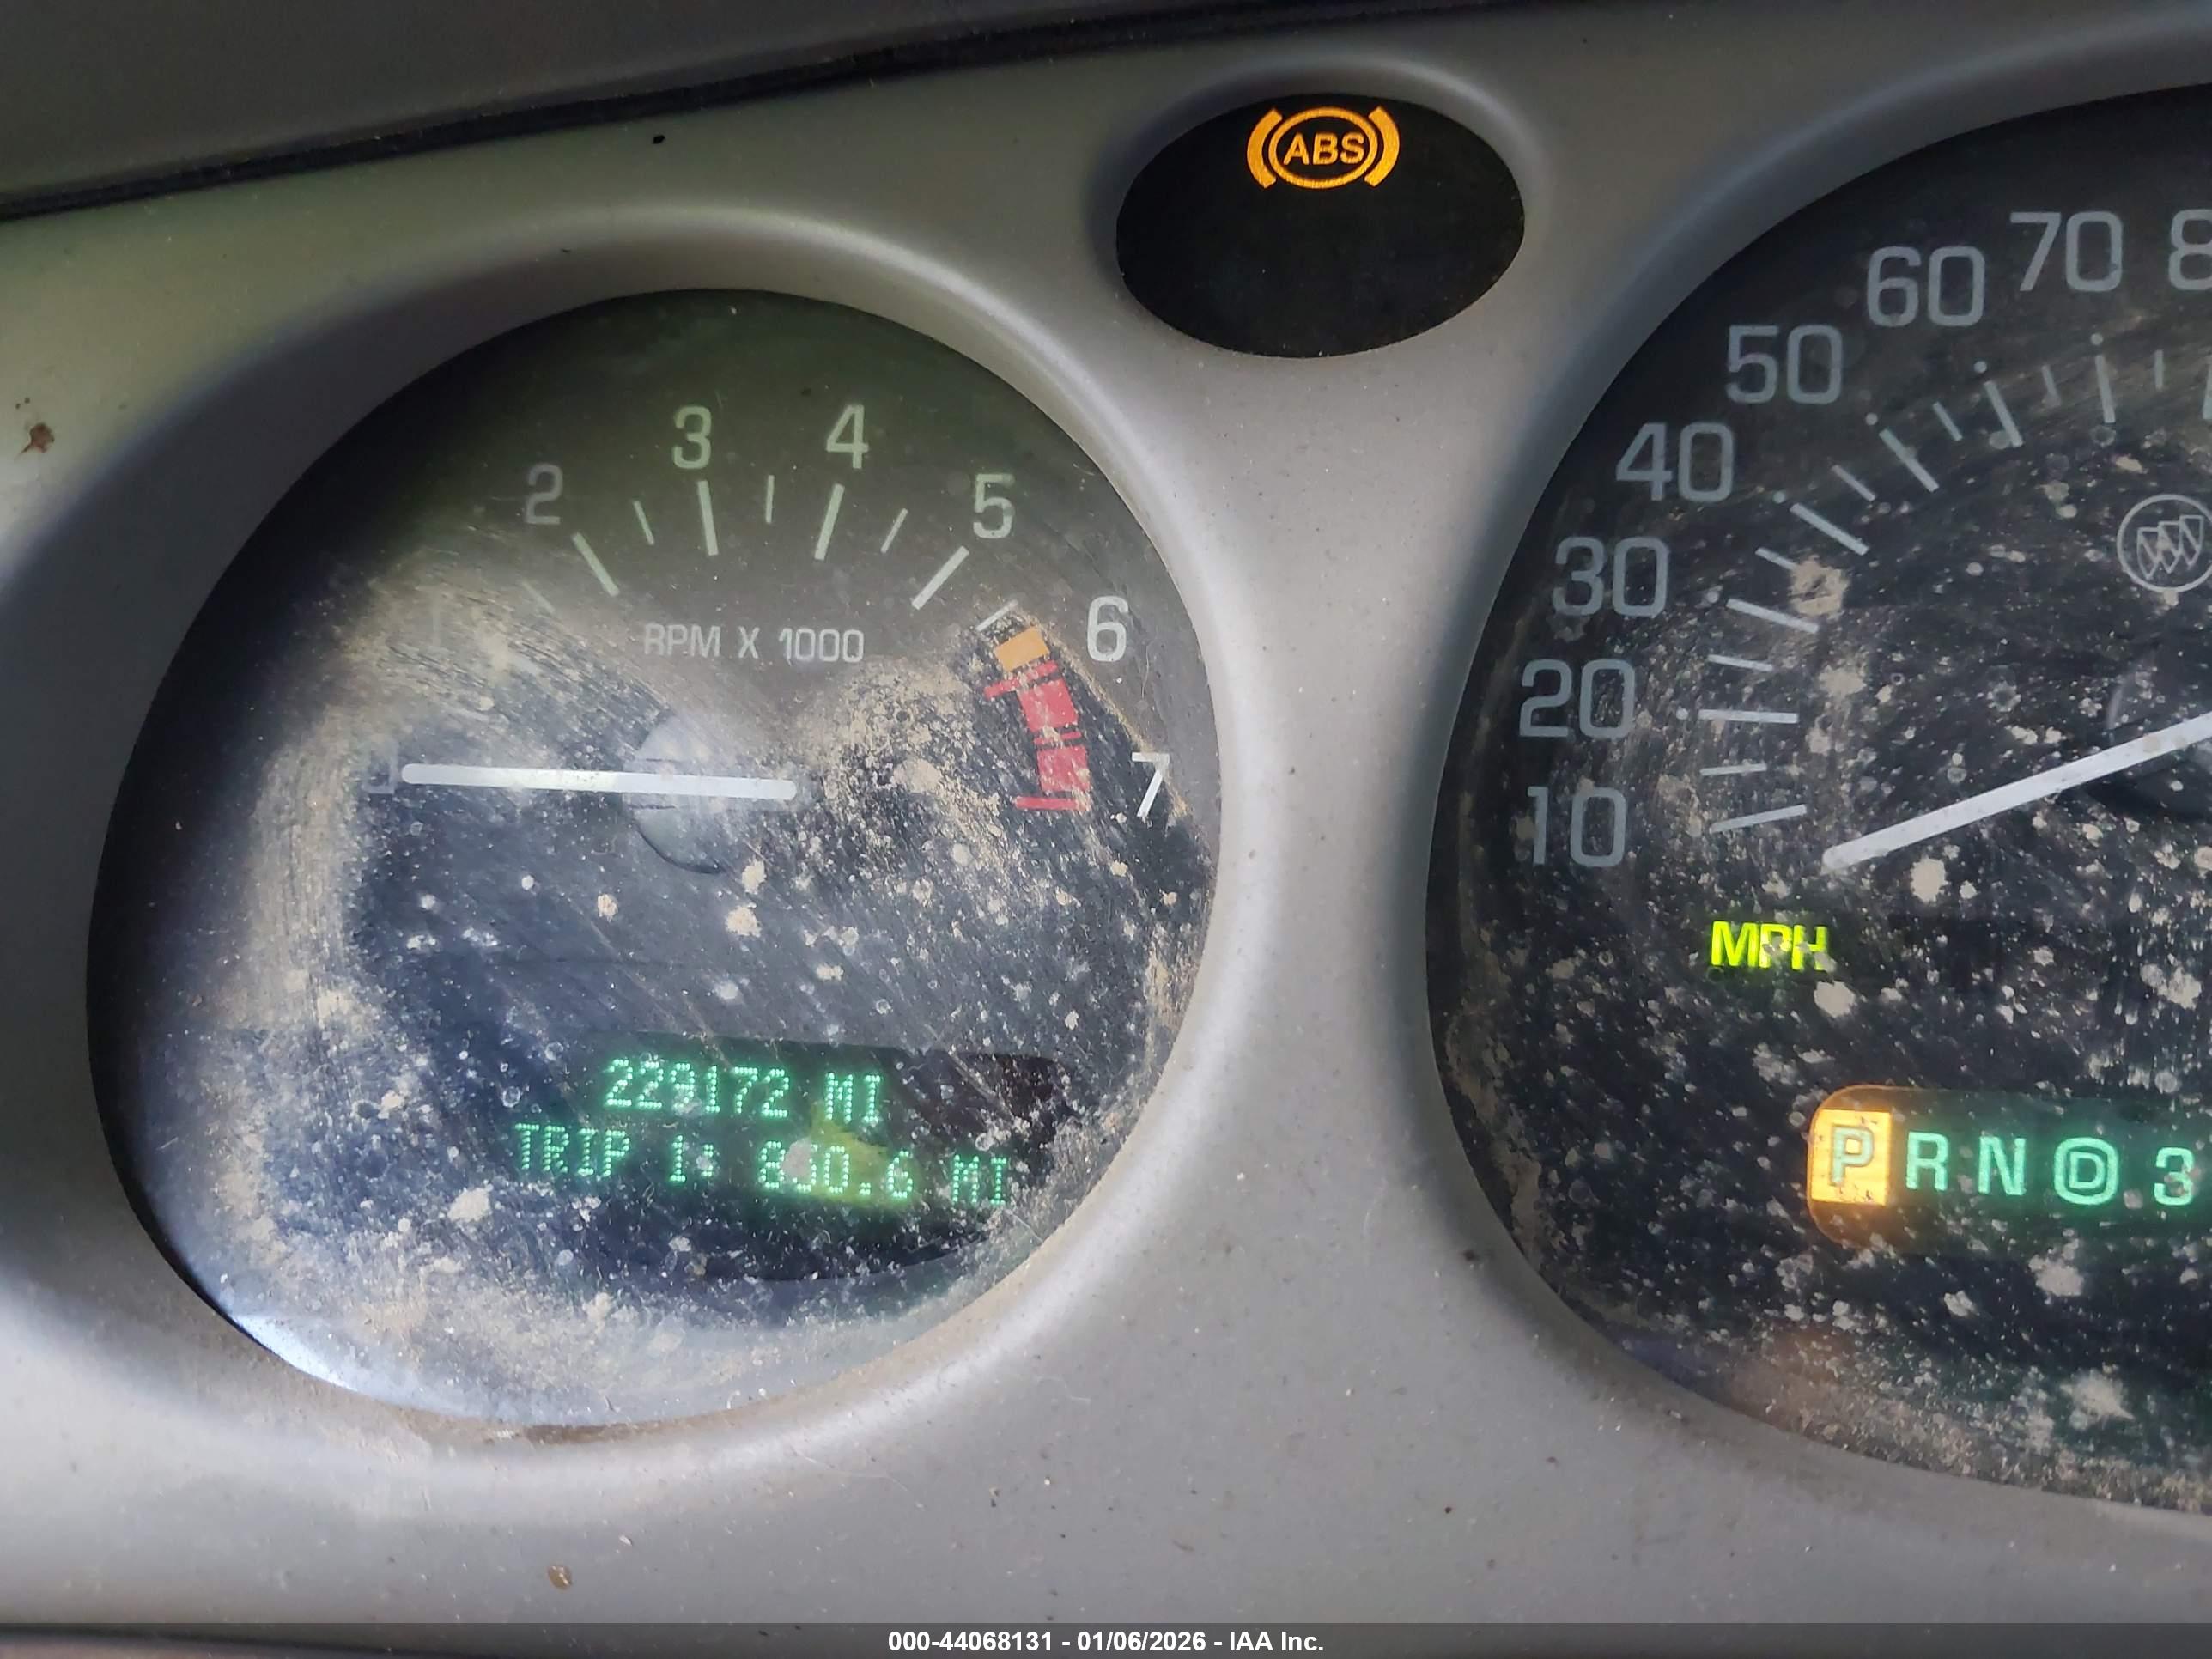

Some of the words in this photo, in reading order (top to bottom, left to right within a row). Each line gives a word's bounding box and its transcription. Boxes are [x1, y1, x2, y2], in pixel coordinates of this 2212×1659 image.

[1284, 132, 1365, 166] ABS
[2010, 210, 2124, 293] 70
[1867, 246, 1985, 328] 60
[1726, 325, 1844, 404] 50
[672, 406, 714, 471] 3
[825, 404, 869, 470] 4
[1614, 422, 1735, 503] 40
[525, 464, 564, 526] 2
[973, 473, 1014, 538] 5
[1552, 536, 1669, 617] 30
[645, 623, 721, 659] RPM
[738, 626, 760, 659] X
[778, 628, 865, 664] 1000
[1086, 595, 1128, 663] 6
[1518, 658, 1637, 739] 20
[1131, 751, 1171, 818] 7
[1527, 785, 1629, 868] 10
[1711, 921, 1830, 972] MPH
[605, 1058, 790, 1118] 229172
[825, 1071, 884, 1123] MI
[515, 1122, 631, 1179] TRIP
[951, 1152, 1011, 1206] MI
[1830, 1124, 1876, 1188] P
[1905, 1131, 1948, 1191] R
[1978, 1136, 2027, 1197] N
[2152, 1146, 2196, 1206] 3
